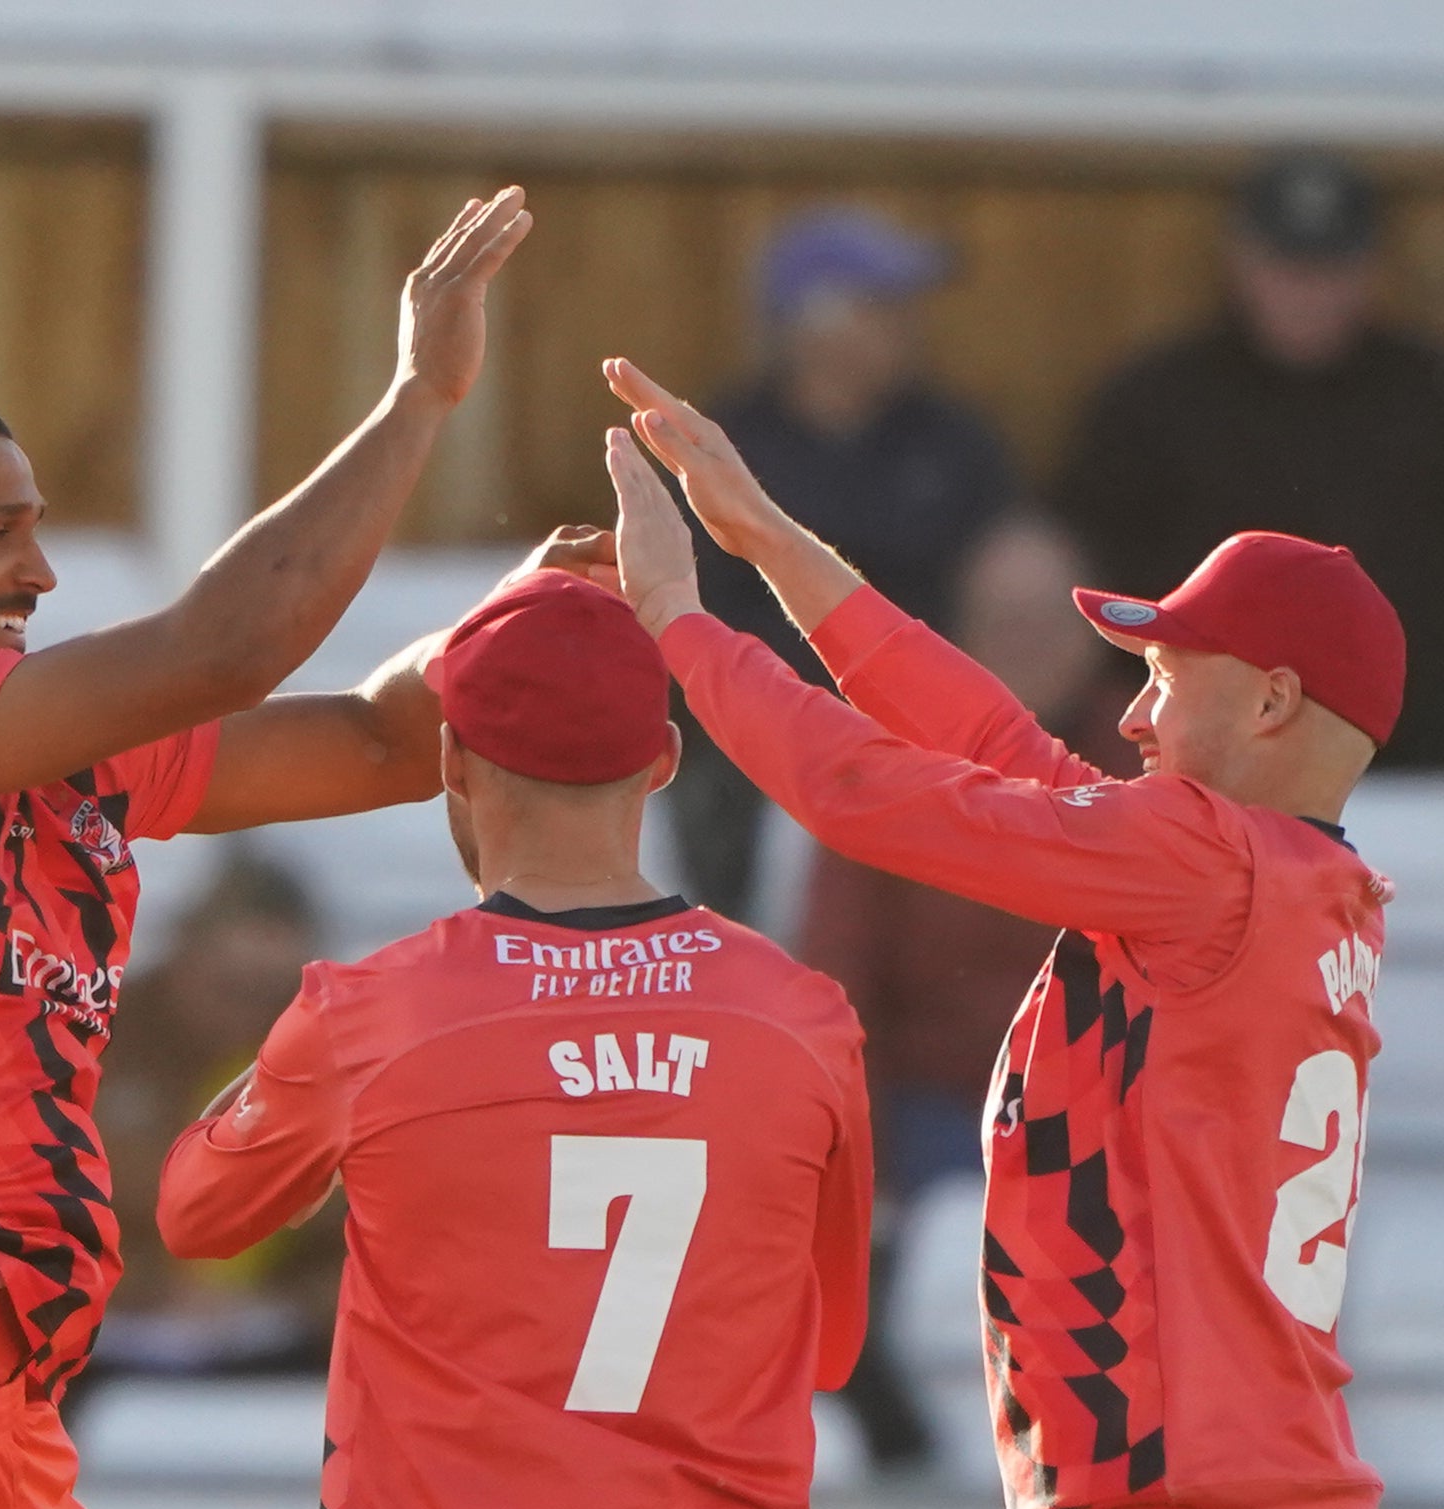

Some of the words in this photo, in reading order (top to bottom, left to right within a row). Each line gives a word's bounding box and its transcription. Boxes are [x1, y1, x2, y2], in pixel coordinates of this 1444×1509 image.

[493, 928, 722, 971] Emirates
[531, 973, 578, 1001] FLY
[589, 961, 693, 997] BETTER
[548, 1032, 709, 1097] SALT
[1263, 1050, 1369, 1333] 2
[548, 1134, 708, 1414] 7
